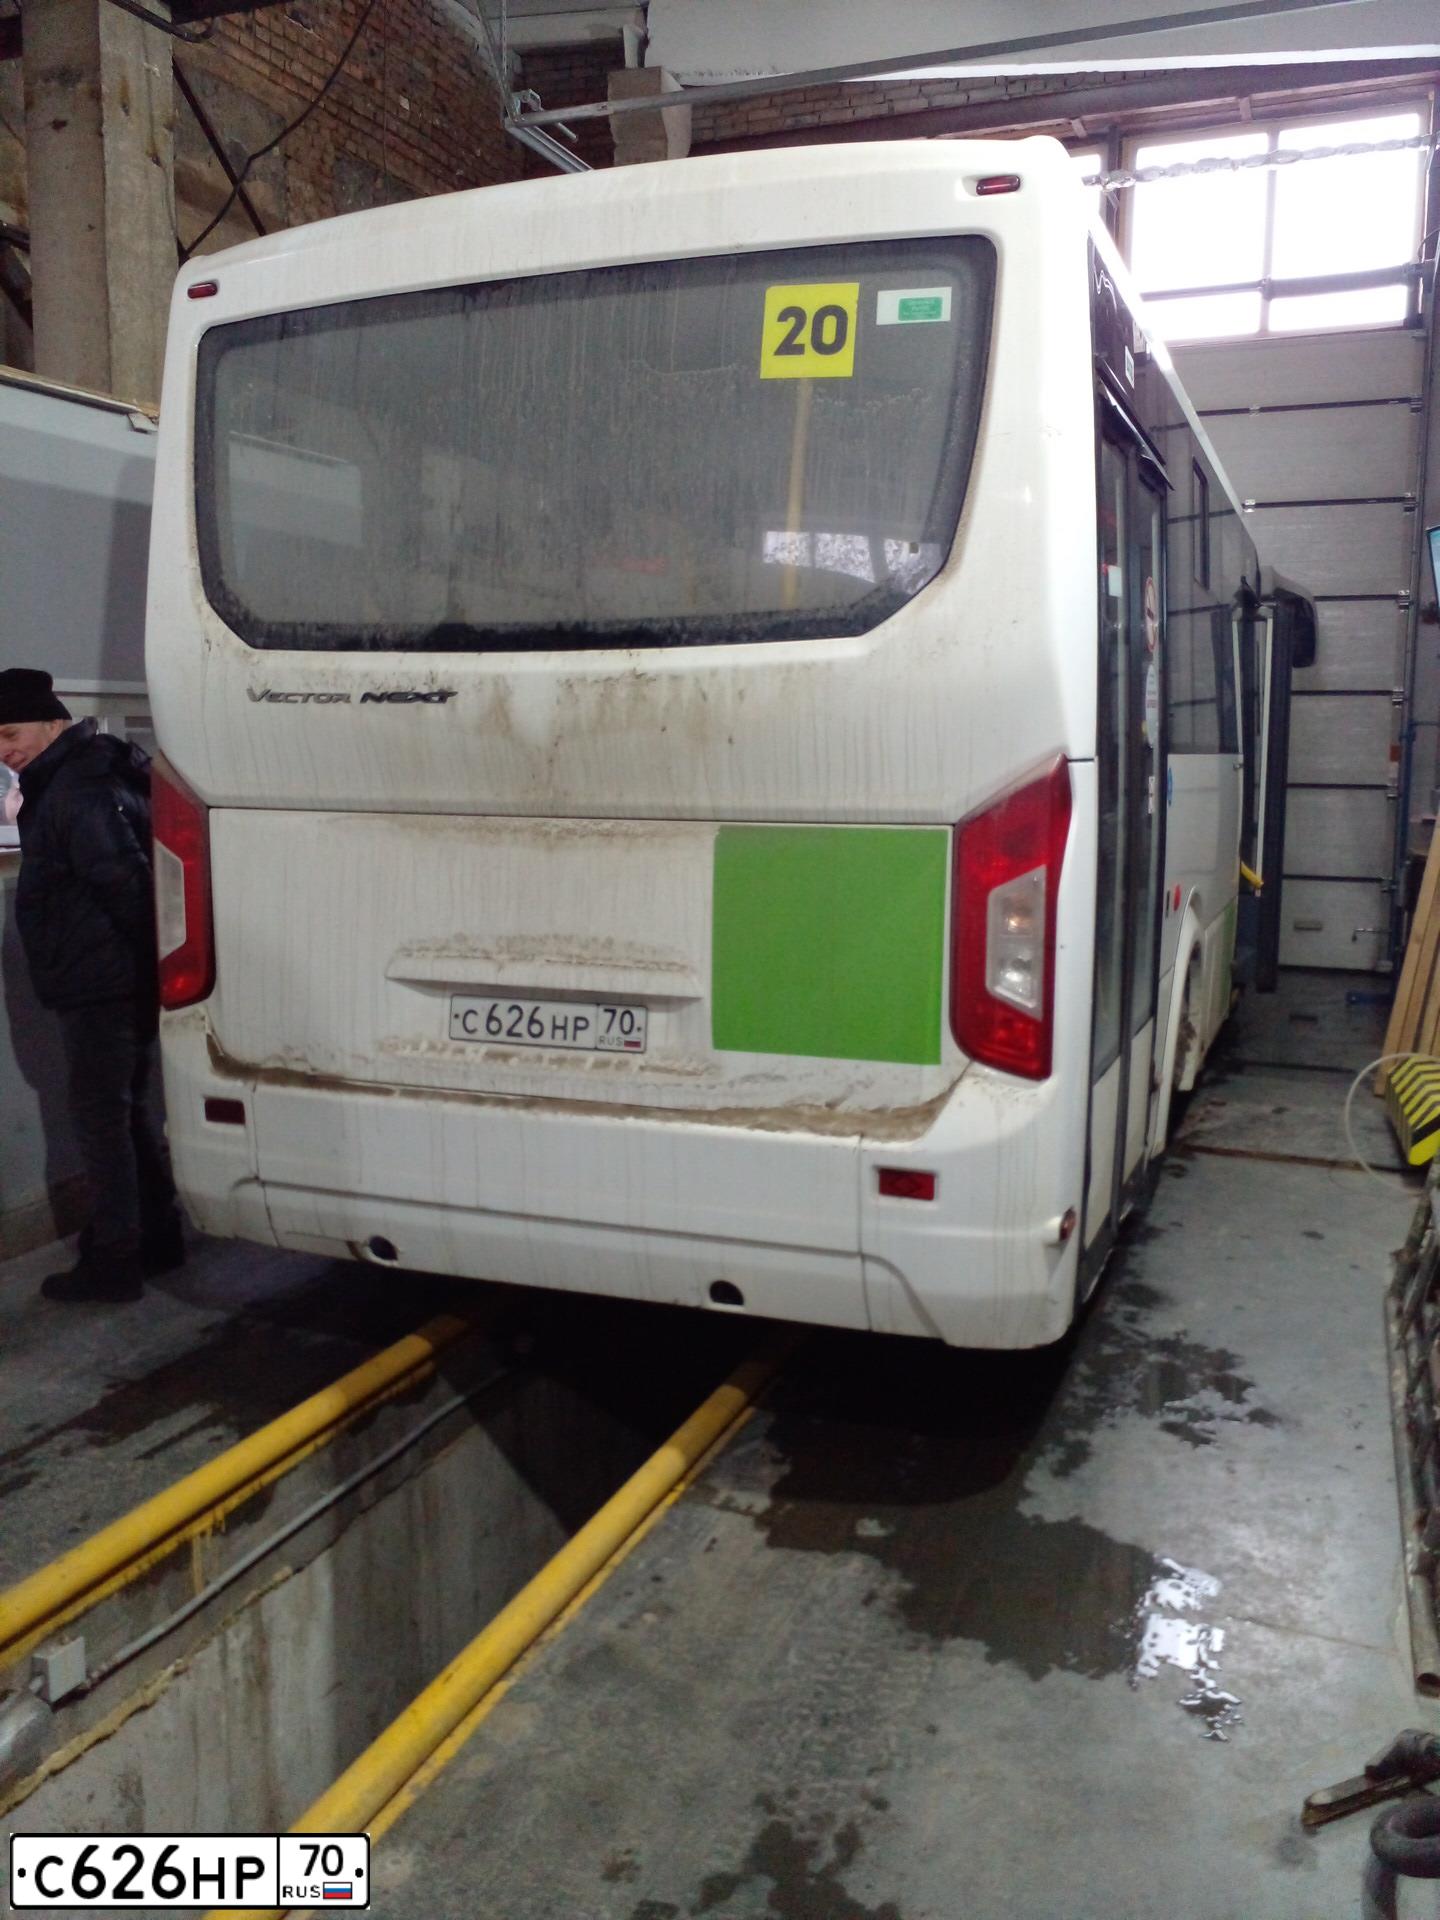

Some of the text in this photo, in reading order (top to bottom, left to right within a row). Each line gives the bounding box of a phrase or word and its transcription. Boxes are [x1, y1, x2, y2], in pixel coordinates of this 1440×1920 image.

[773, 304, 849, 356] 20
[462, 1003, 635, 1041] С626НР 70
[599, 1035, 624, 1047] RUS
